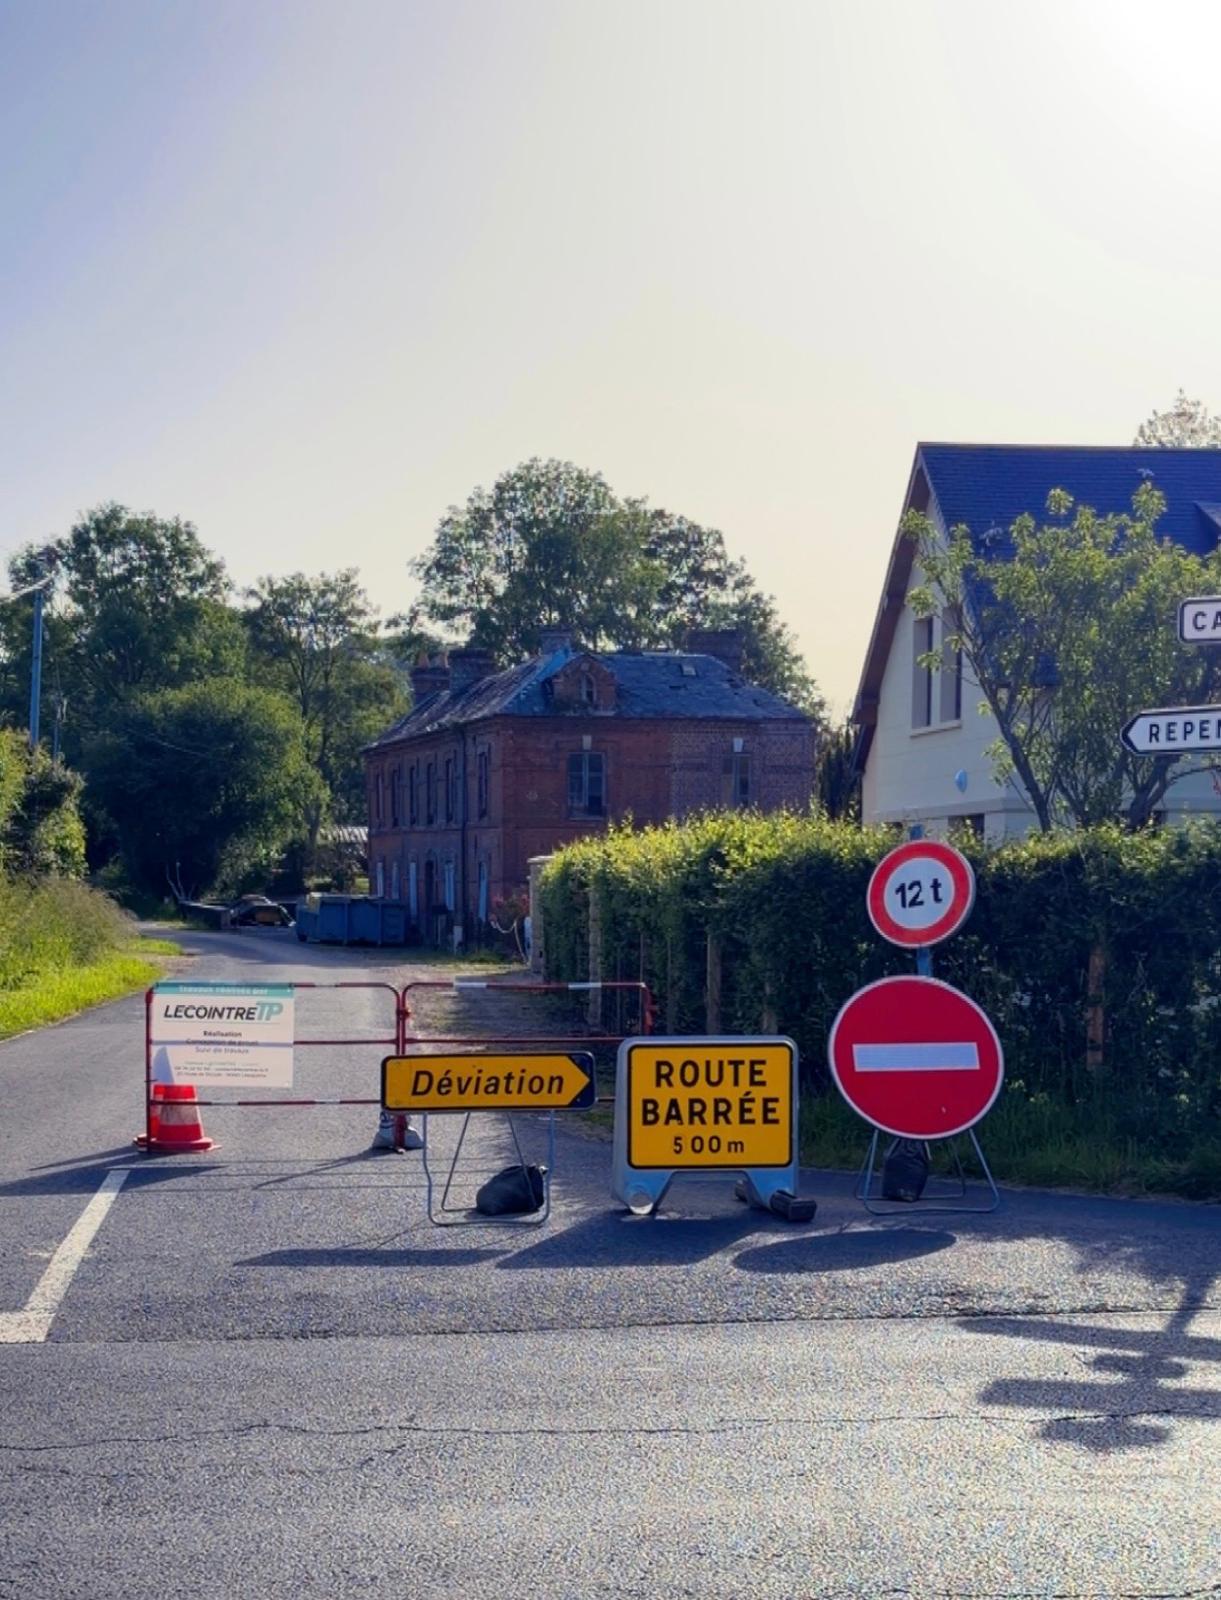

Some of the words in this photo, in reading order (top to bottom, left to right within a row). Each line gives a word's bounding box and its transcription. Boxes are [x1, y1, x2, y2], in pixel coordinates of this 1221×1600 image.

[895, 880, 924, 909] 12
[930, 878, 943, 904] t
[203, 1030, 242, 1038] Réalisation
[411, 1068, 564, 1096] Déviation
[655, 1059, 767, 1088] ROUTE
[641, 1091, 780, 1126] BARRÉE
